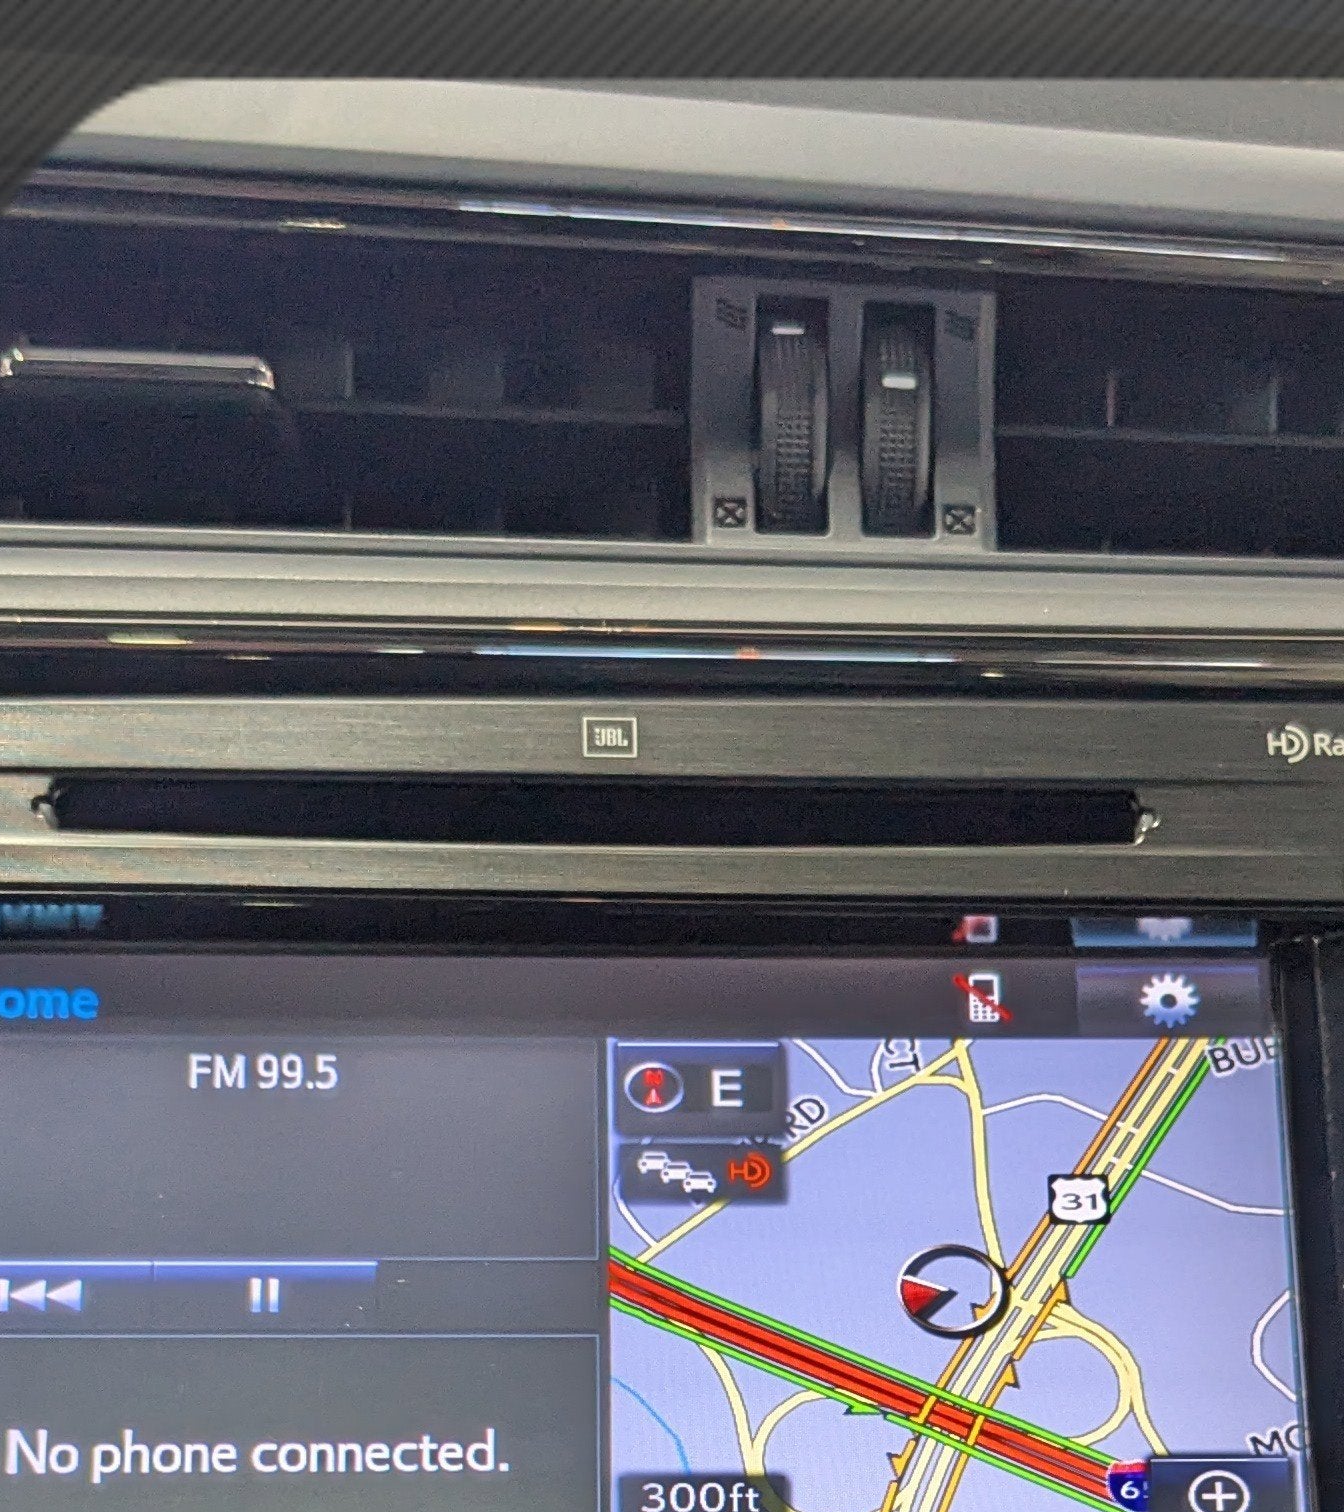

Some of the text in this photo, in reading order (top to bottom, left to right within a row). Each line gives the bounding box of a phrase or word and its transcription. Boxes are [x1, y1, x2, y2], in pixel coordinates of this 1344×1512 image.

[594, 727, 629, 747] JBL
[188, 1054, 339, 1091] FM 99.5
[711, 1069, 744, 1107] E
[1061, 1192, 1098, 1211] 31
[6, 1428, 511, 1483] No phone connected.
